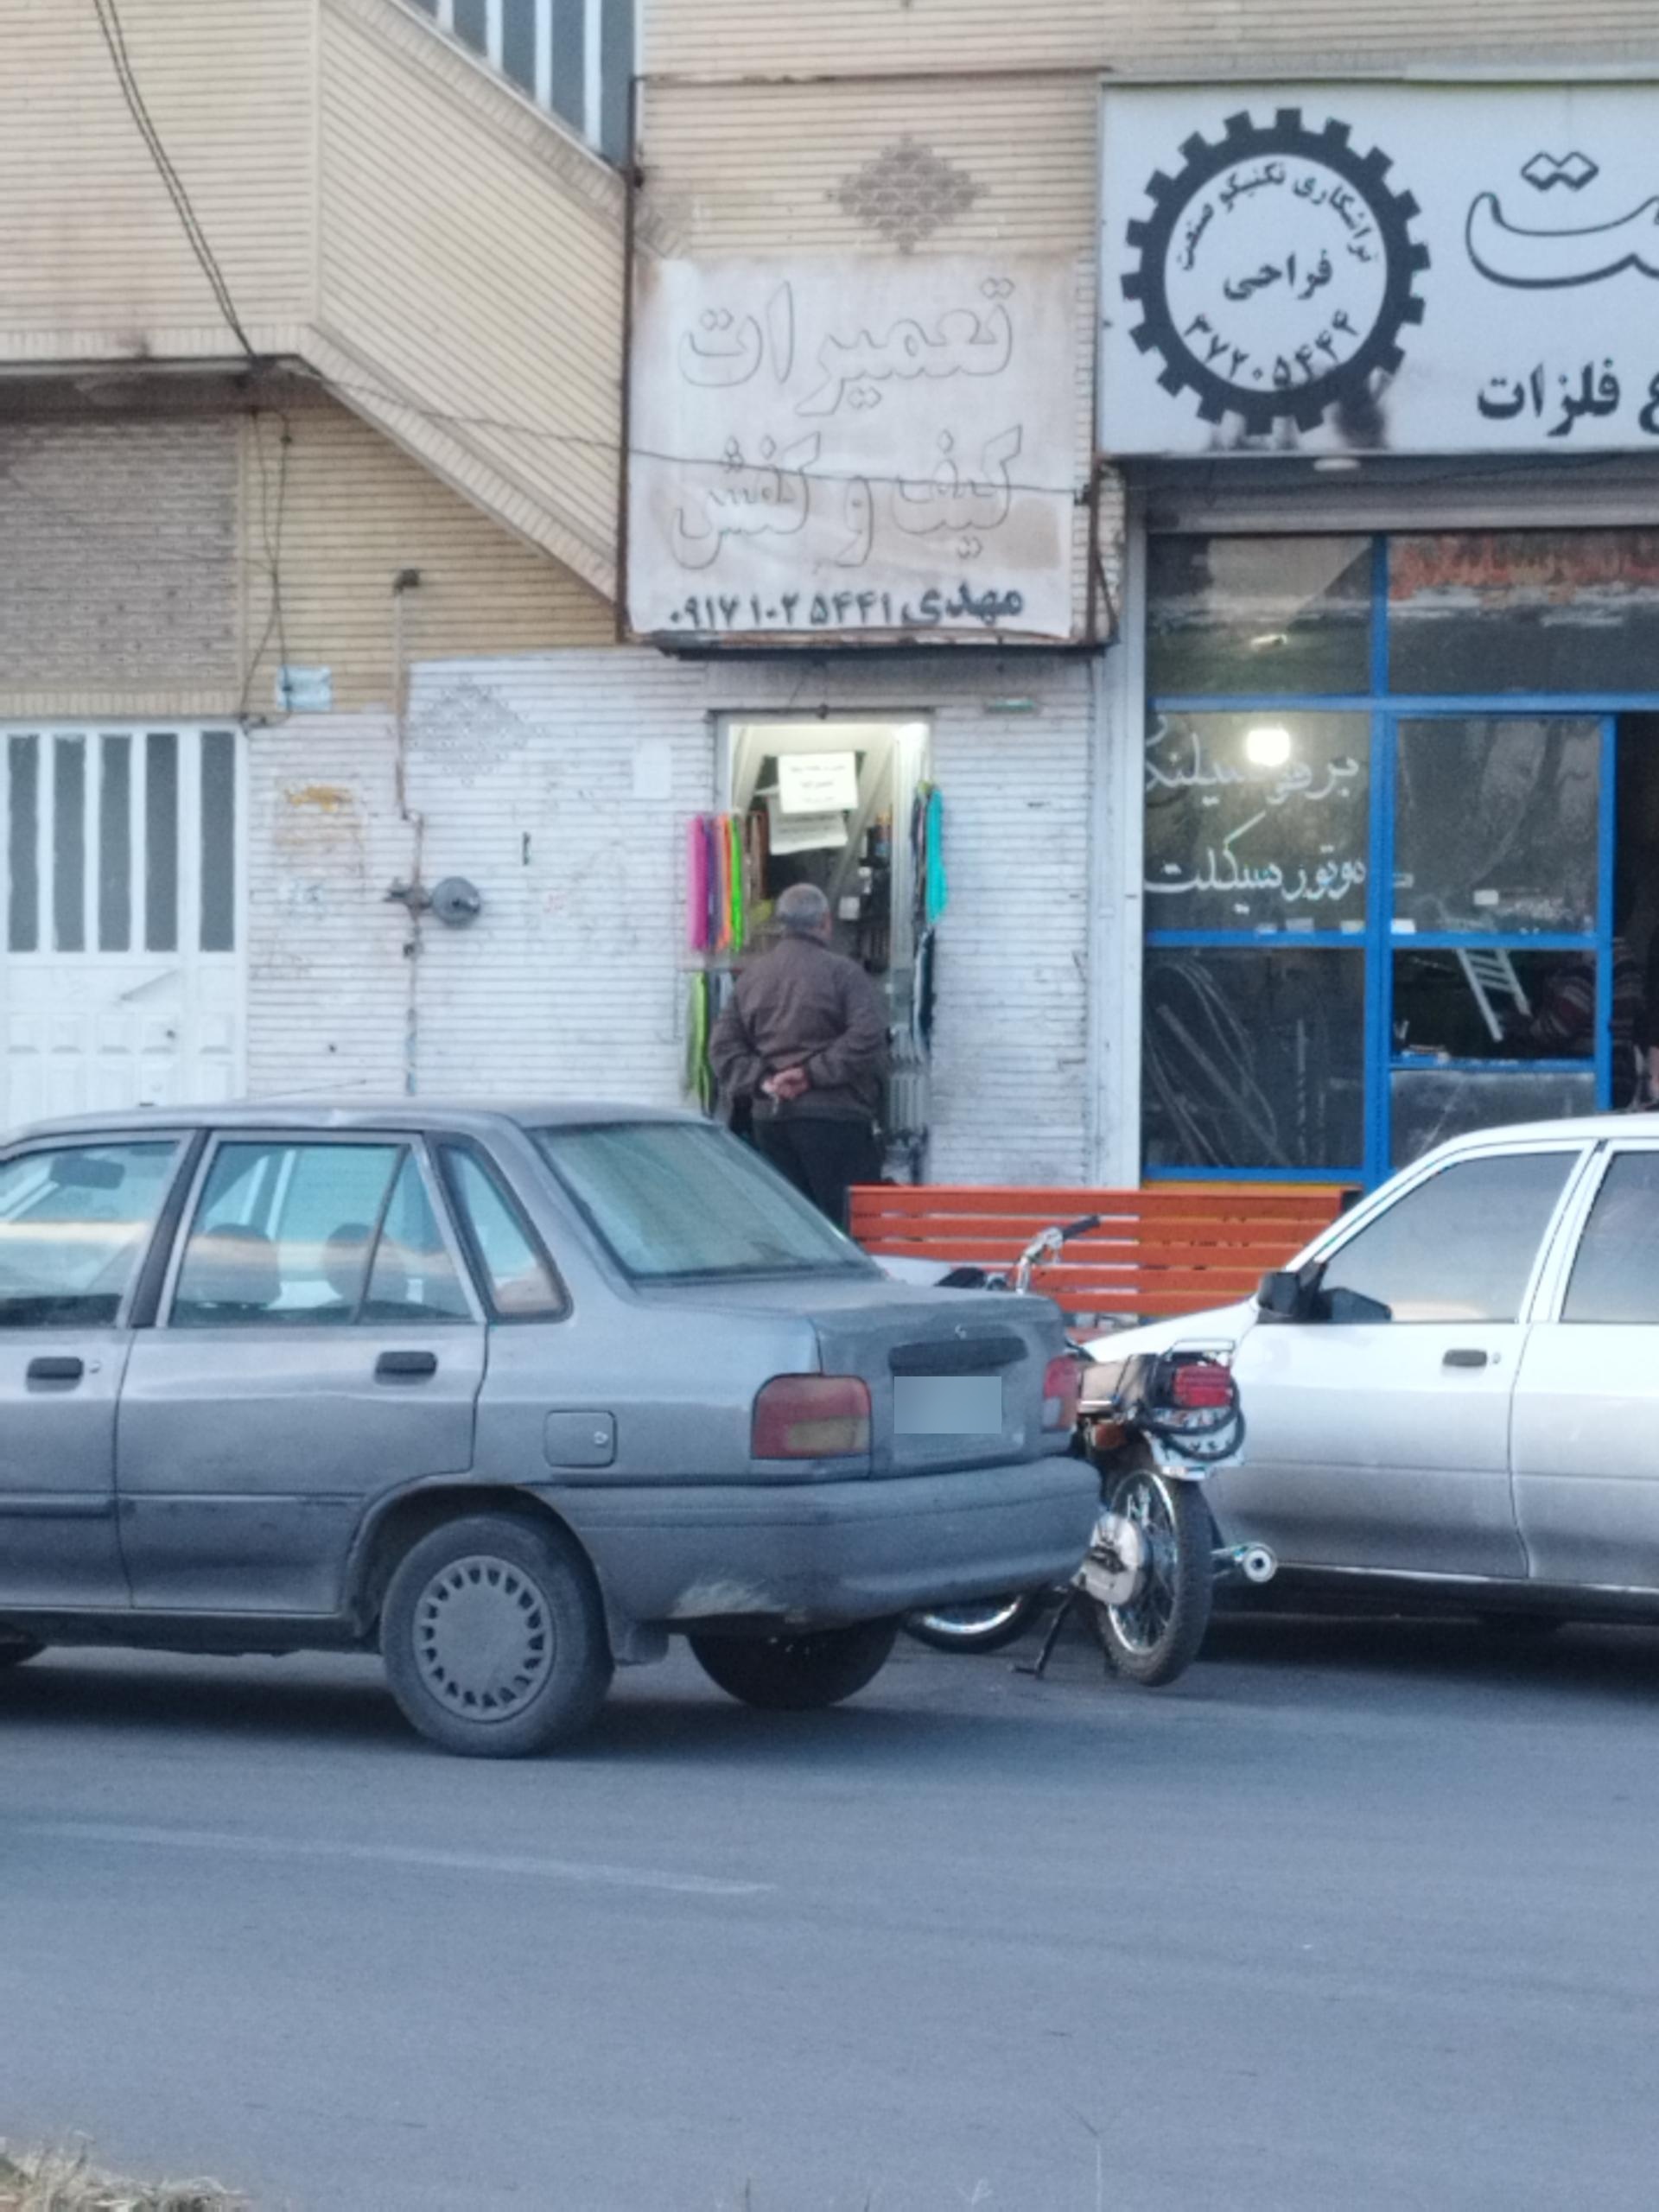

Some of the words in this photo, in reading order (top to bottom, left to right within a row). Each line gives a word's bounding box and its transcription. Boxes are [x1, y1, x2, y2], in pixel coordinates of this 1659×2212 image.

[1223, 248, 1333, 302] فراحی
[680, 277, 1014, 416] تعمیرات
[1477, 357, 1621, 437] فلزات
[671, 431, 822, 570] کفش
[893, 424, 1023, 560] کیف
[901, 579, 1024, 626] مهدی
